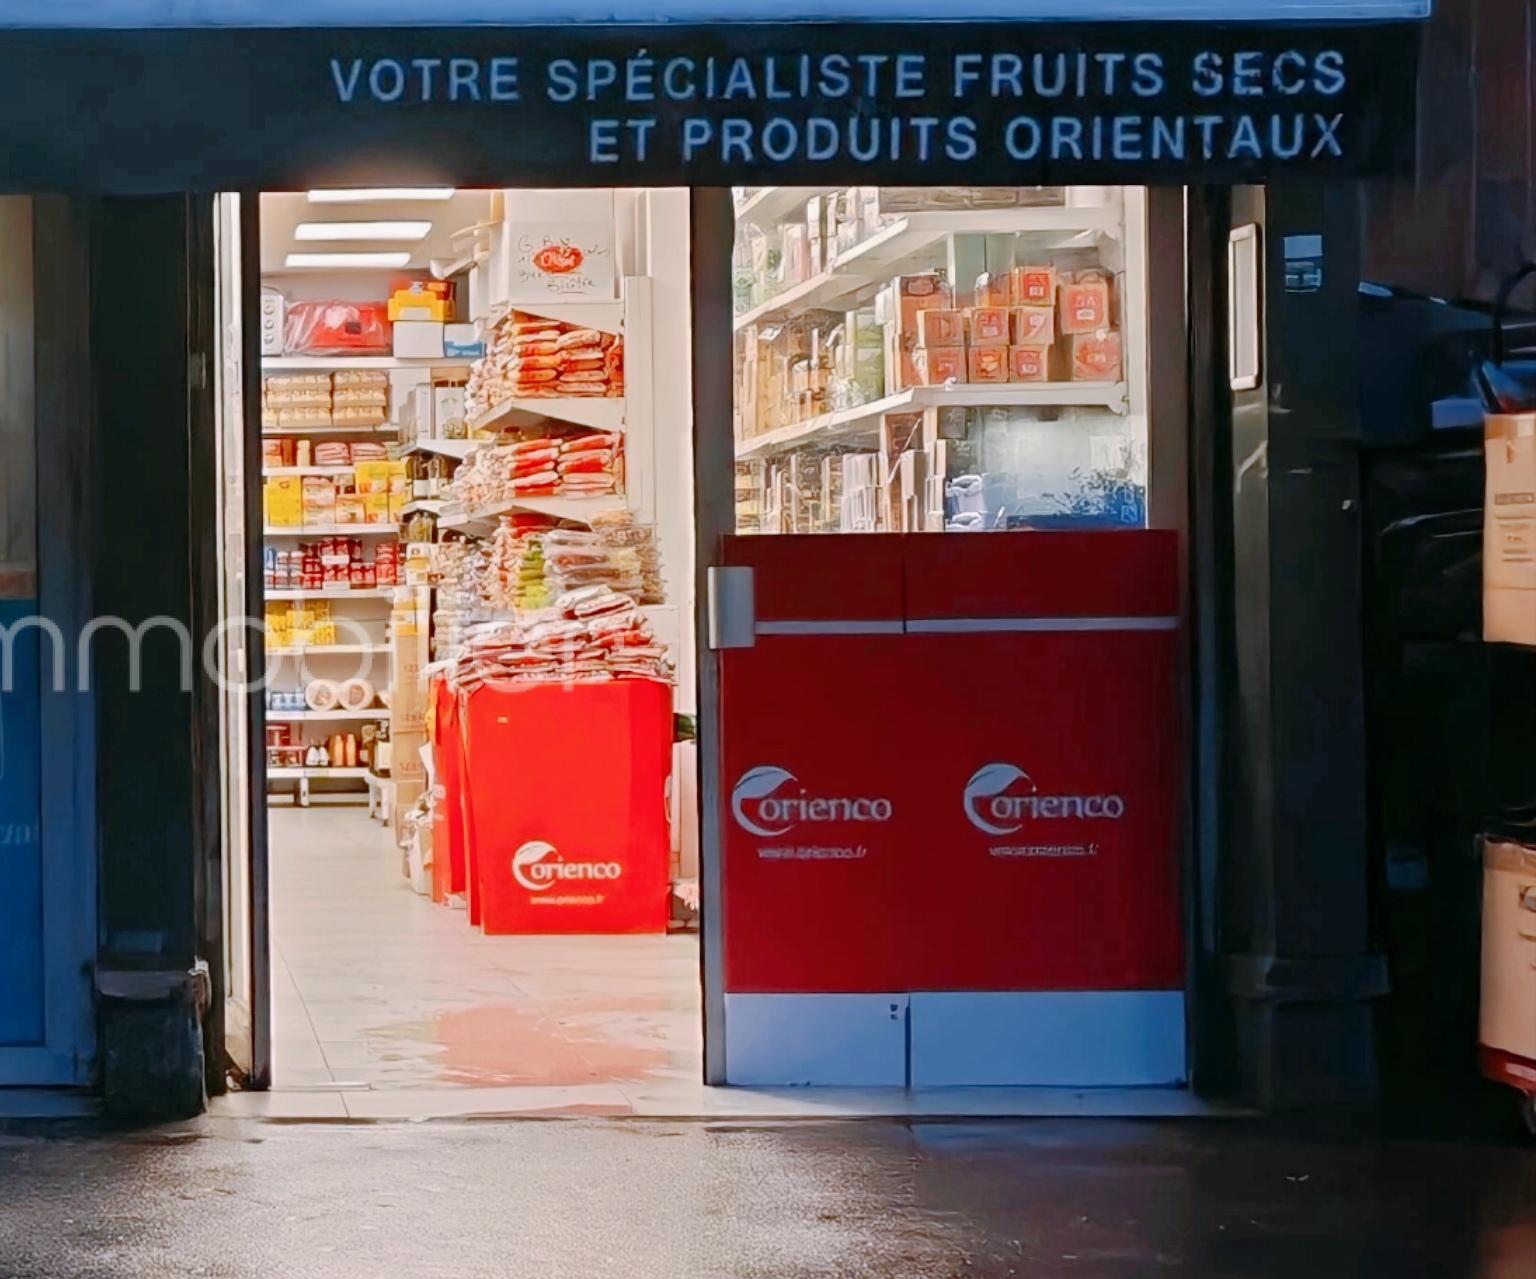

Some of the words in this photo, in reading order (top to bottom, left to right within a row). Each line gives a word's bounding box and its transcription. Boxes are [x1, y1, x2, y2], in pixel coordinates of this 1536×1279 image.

[330, 57, 520, 102] VOTRE
[546, 48, 926, 101] SPÉCIALISTE
[953, 52, 1165, 97] FRUITS
[1192, 50, 1347, 96] SECS
[589, 119, 656, 162] ET
[682, 117, 978, 162] PRODUITS
[1004, 113, 1345, 161] ORIENTAUX
[758, 788, 893, 822] orienco
[991, 784, 1124, 820] orienco
[530, 855, 622, 880] orienco
